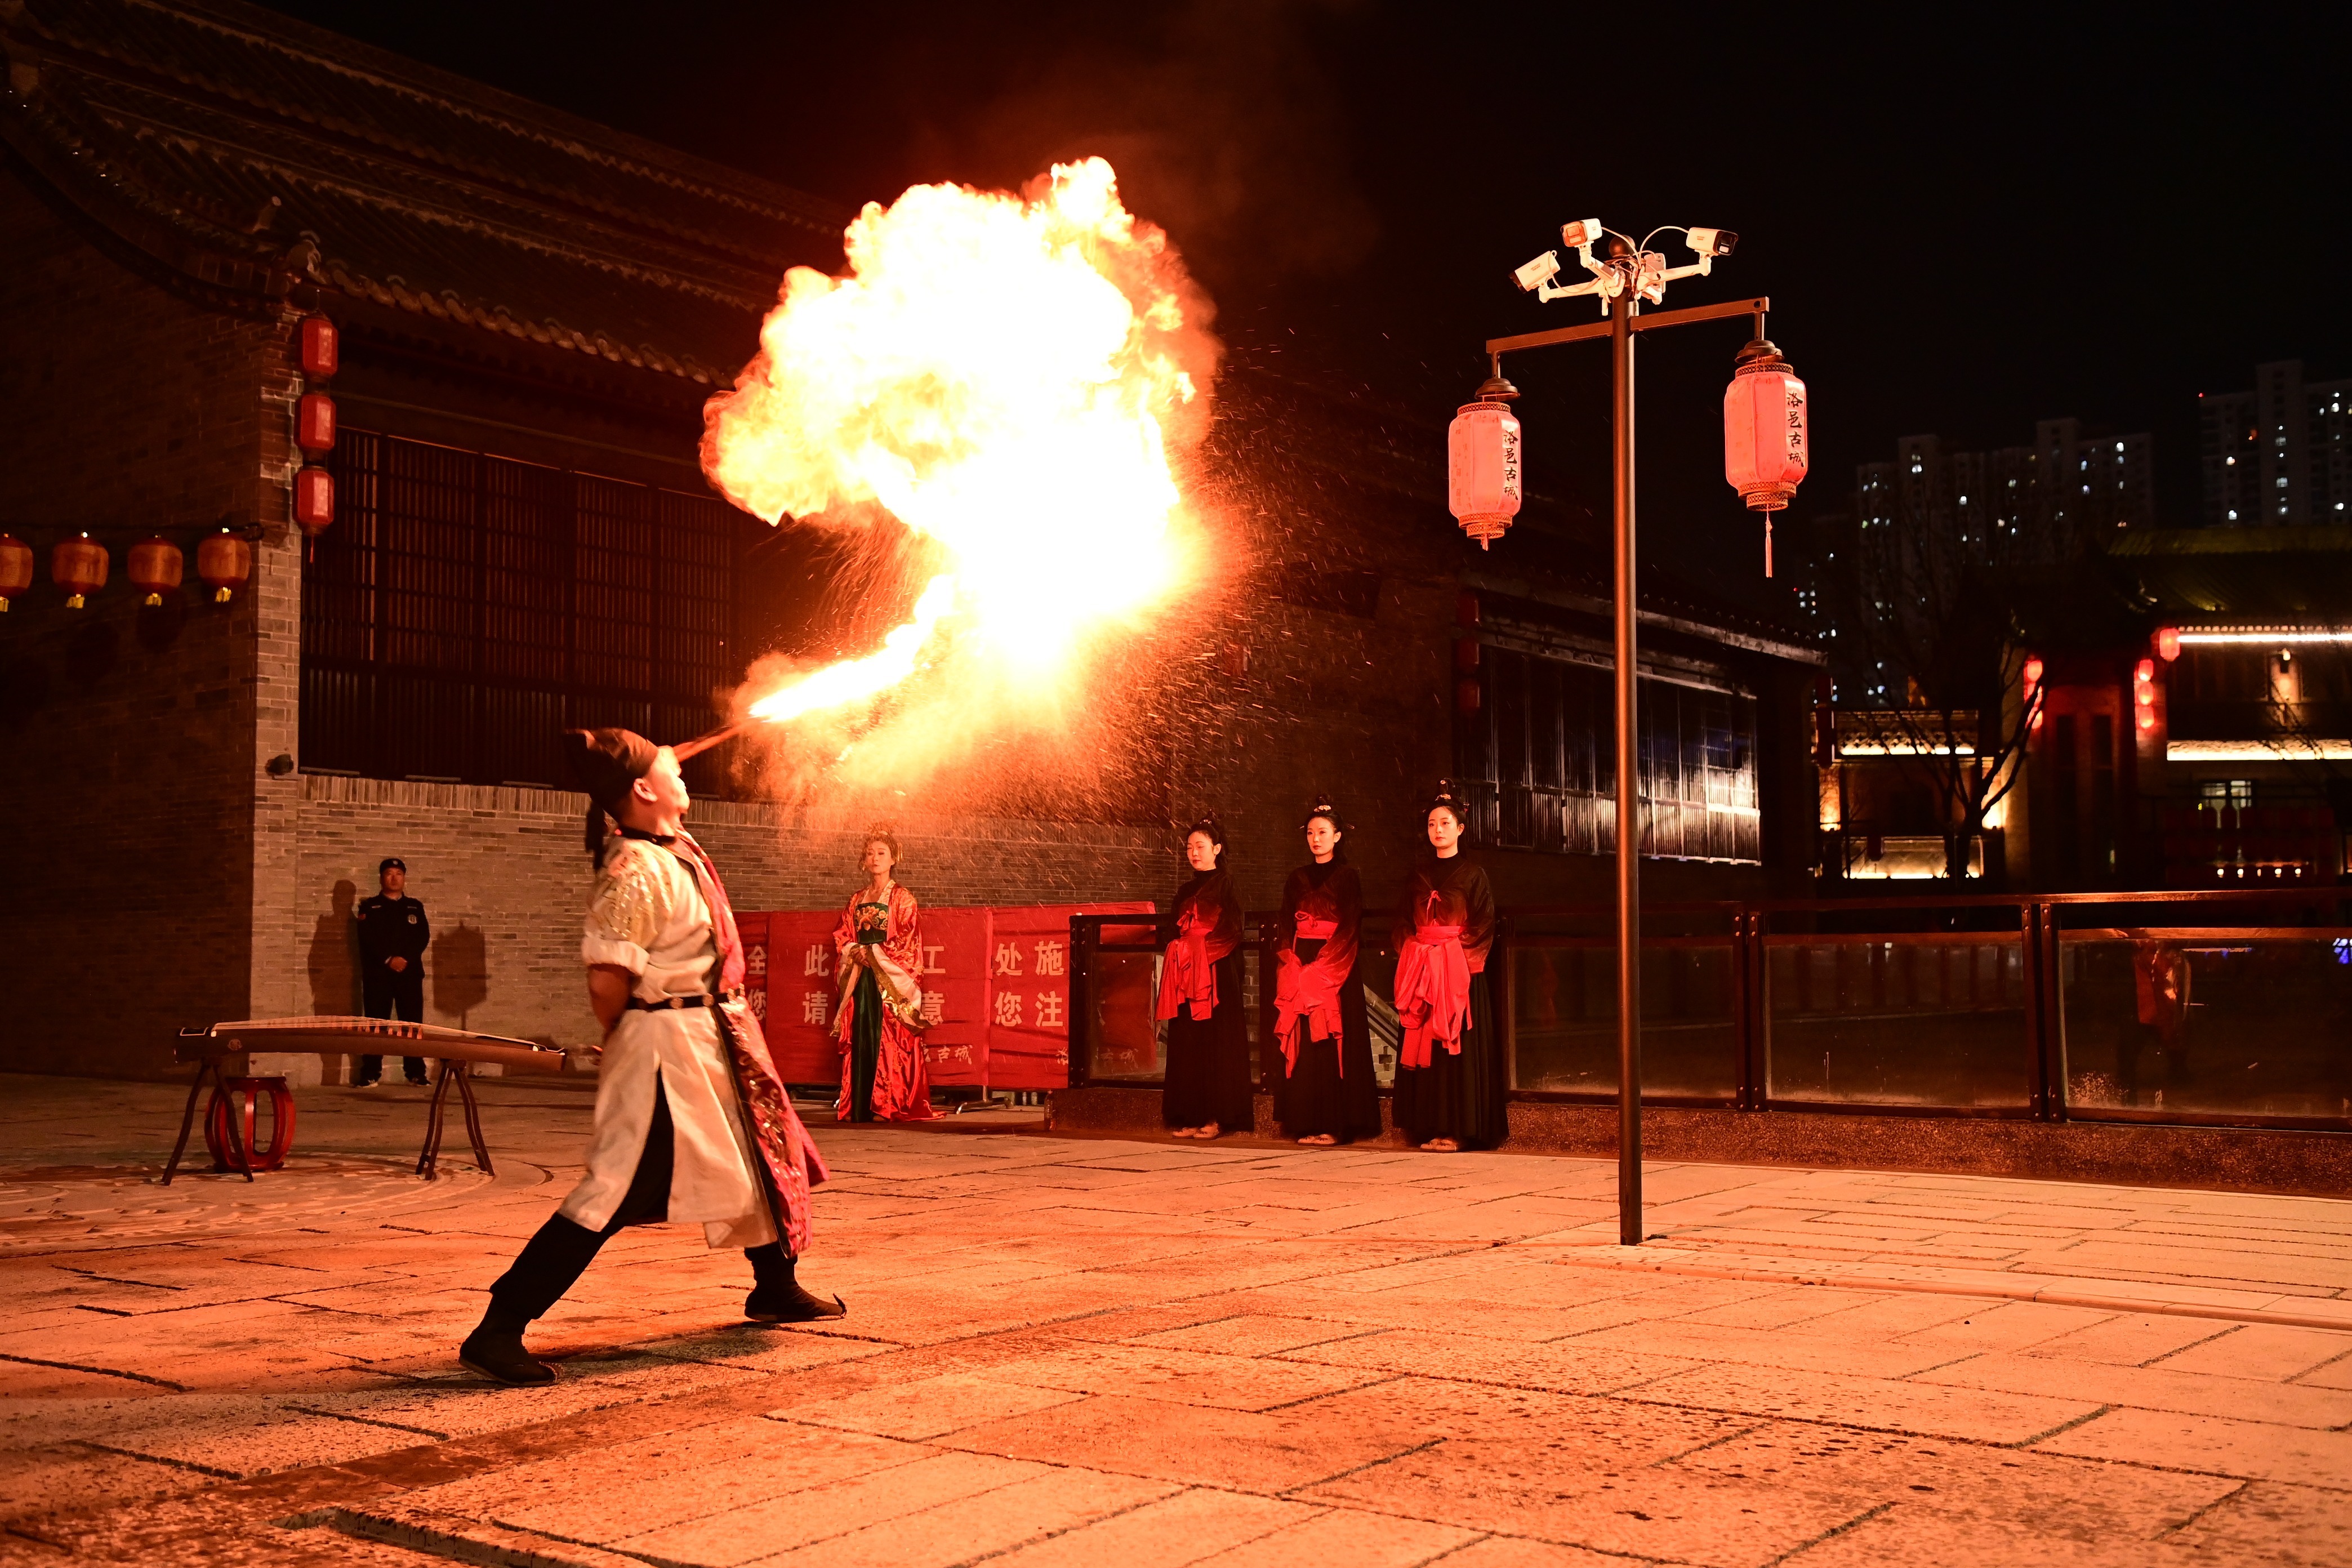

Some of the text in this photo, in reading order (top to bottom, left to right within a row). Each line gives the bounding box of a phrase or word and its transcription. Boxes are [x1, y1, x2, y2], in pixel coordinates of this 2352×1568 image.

[1787, 392, 1804, 467] 洛邑古城
[1503, 430, 1518, 501] 洛邑古城
[747, 944, 767, 975] 全
